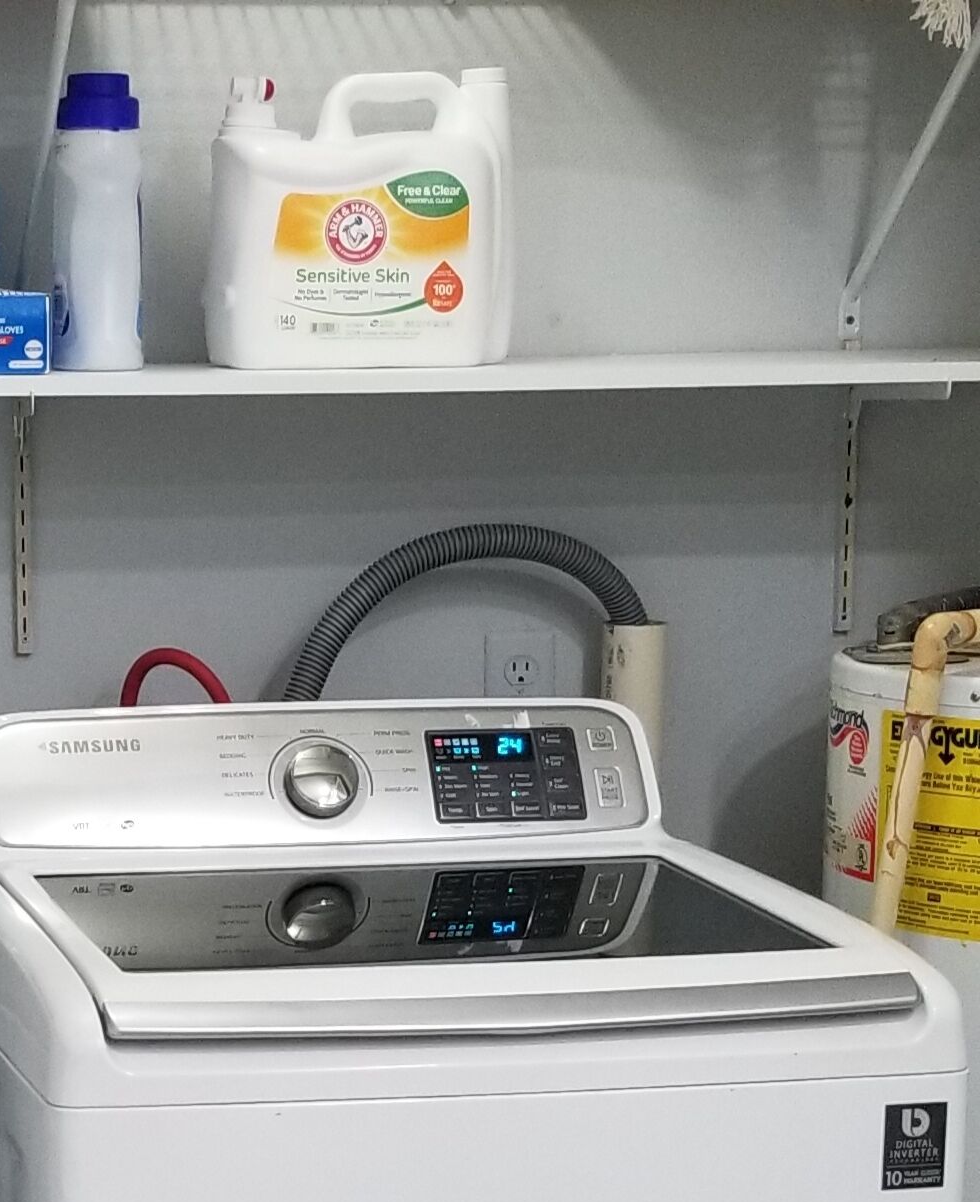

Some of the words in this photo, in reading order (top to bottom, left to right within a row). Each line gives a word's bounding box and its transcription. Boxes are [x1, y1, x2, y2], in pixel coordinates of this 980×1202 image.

[397, 184, 422, 197] Free
[431, 184, 461, 196] Clear
[350, 203, 384, 238] HAMMER
[295, 268, 371, 283] Sensitive
[375, 268, 410, 283] Skin
[280, 315, 296, 326] 140
[49, 738, 142, 754] SAMSUNG
[497, 737, 522, 755] 24
[895, 1139, 934, 1149] DIGITAL
[889, 1147, 939, 1159] INVERTER
[885, 1171, 902, 1187] 10
